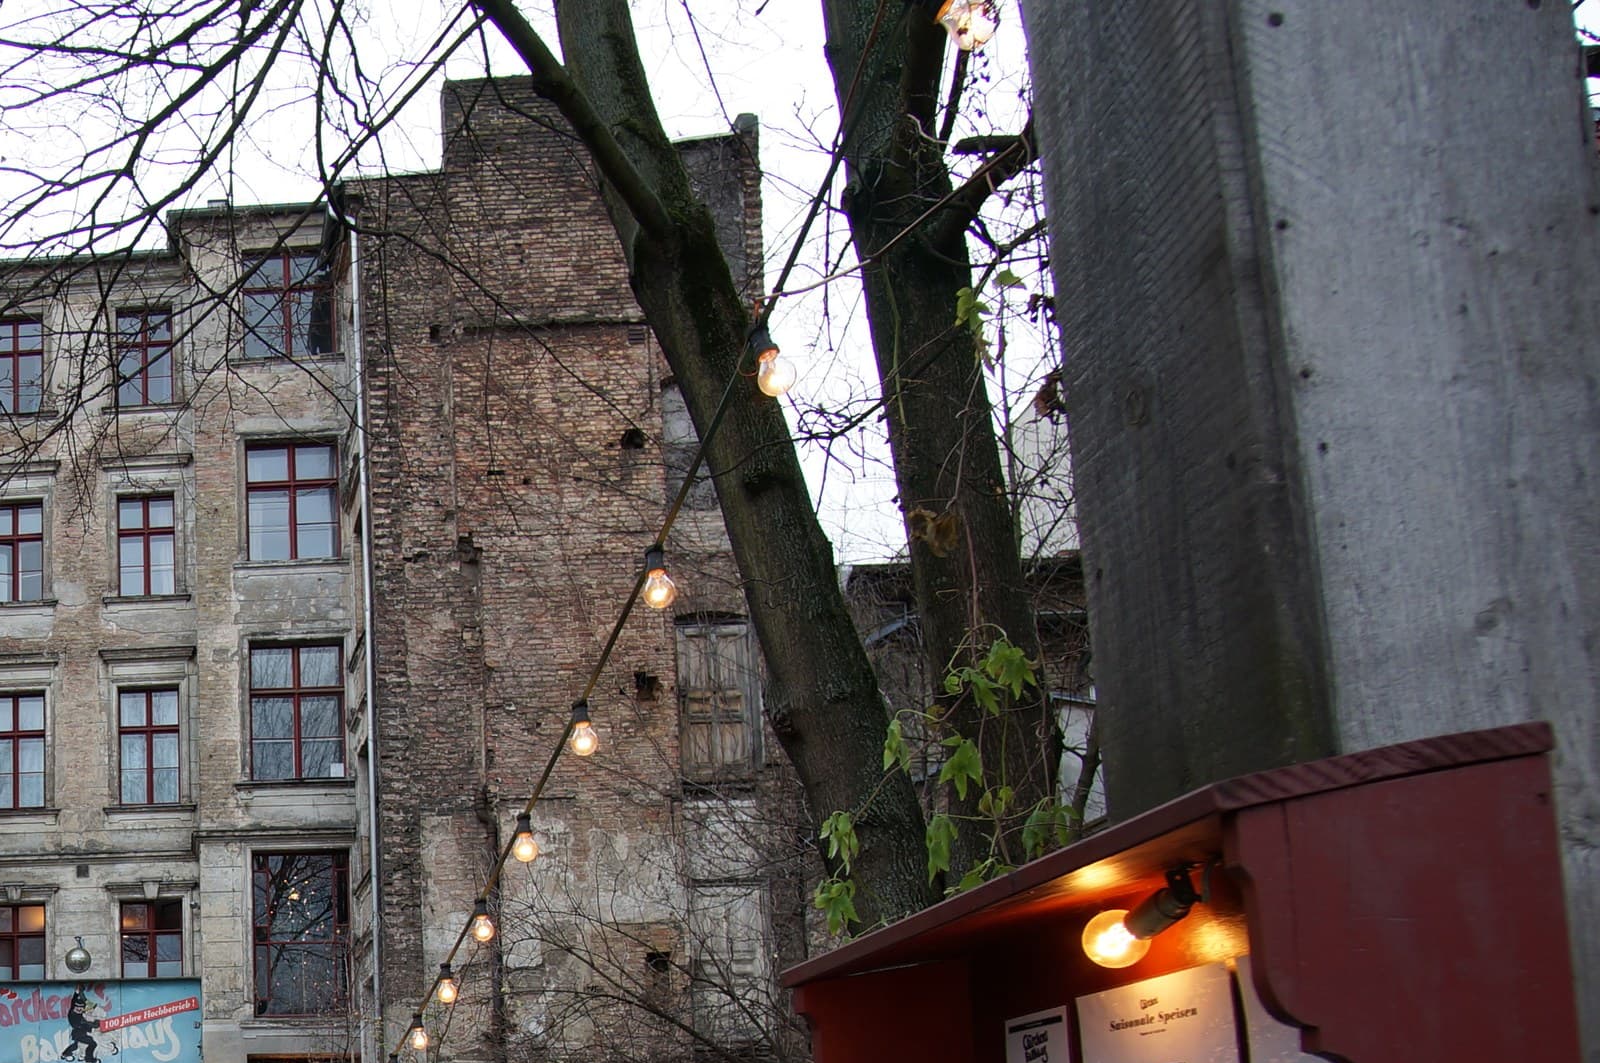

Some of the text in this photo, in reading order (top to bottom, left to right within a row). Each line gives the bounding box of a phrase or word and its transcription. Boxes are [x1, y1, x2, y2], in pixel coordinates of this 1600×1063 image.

[104, 1020, 120, 1030] 100
[120, 1014, 142, 1027] Jahre
[1157, 1007, 1198, 1025] Speisen
